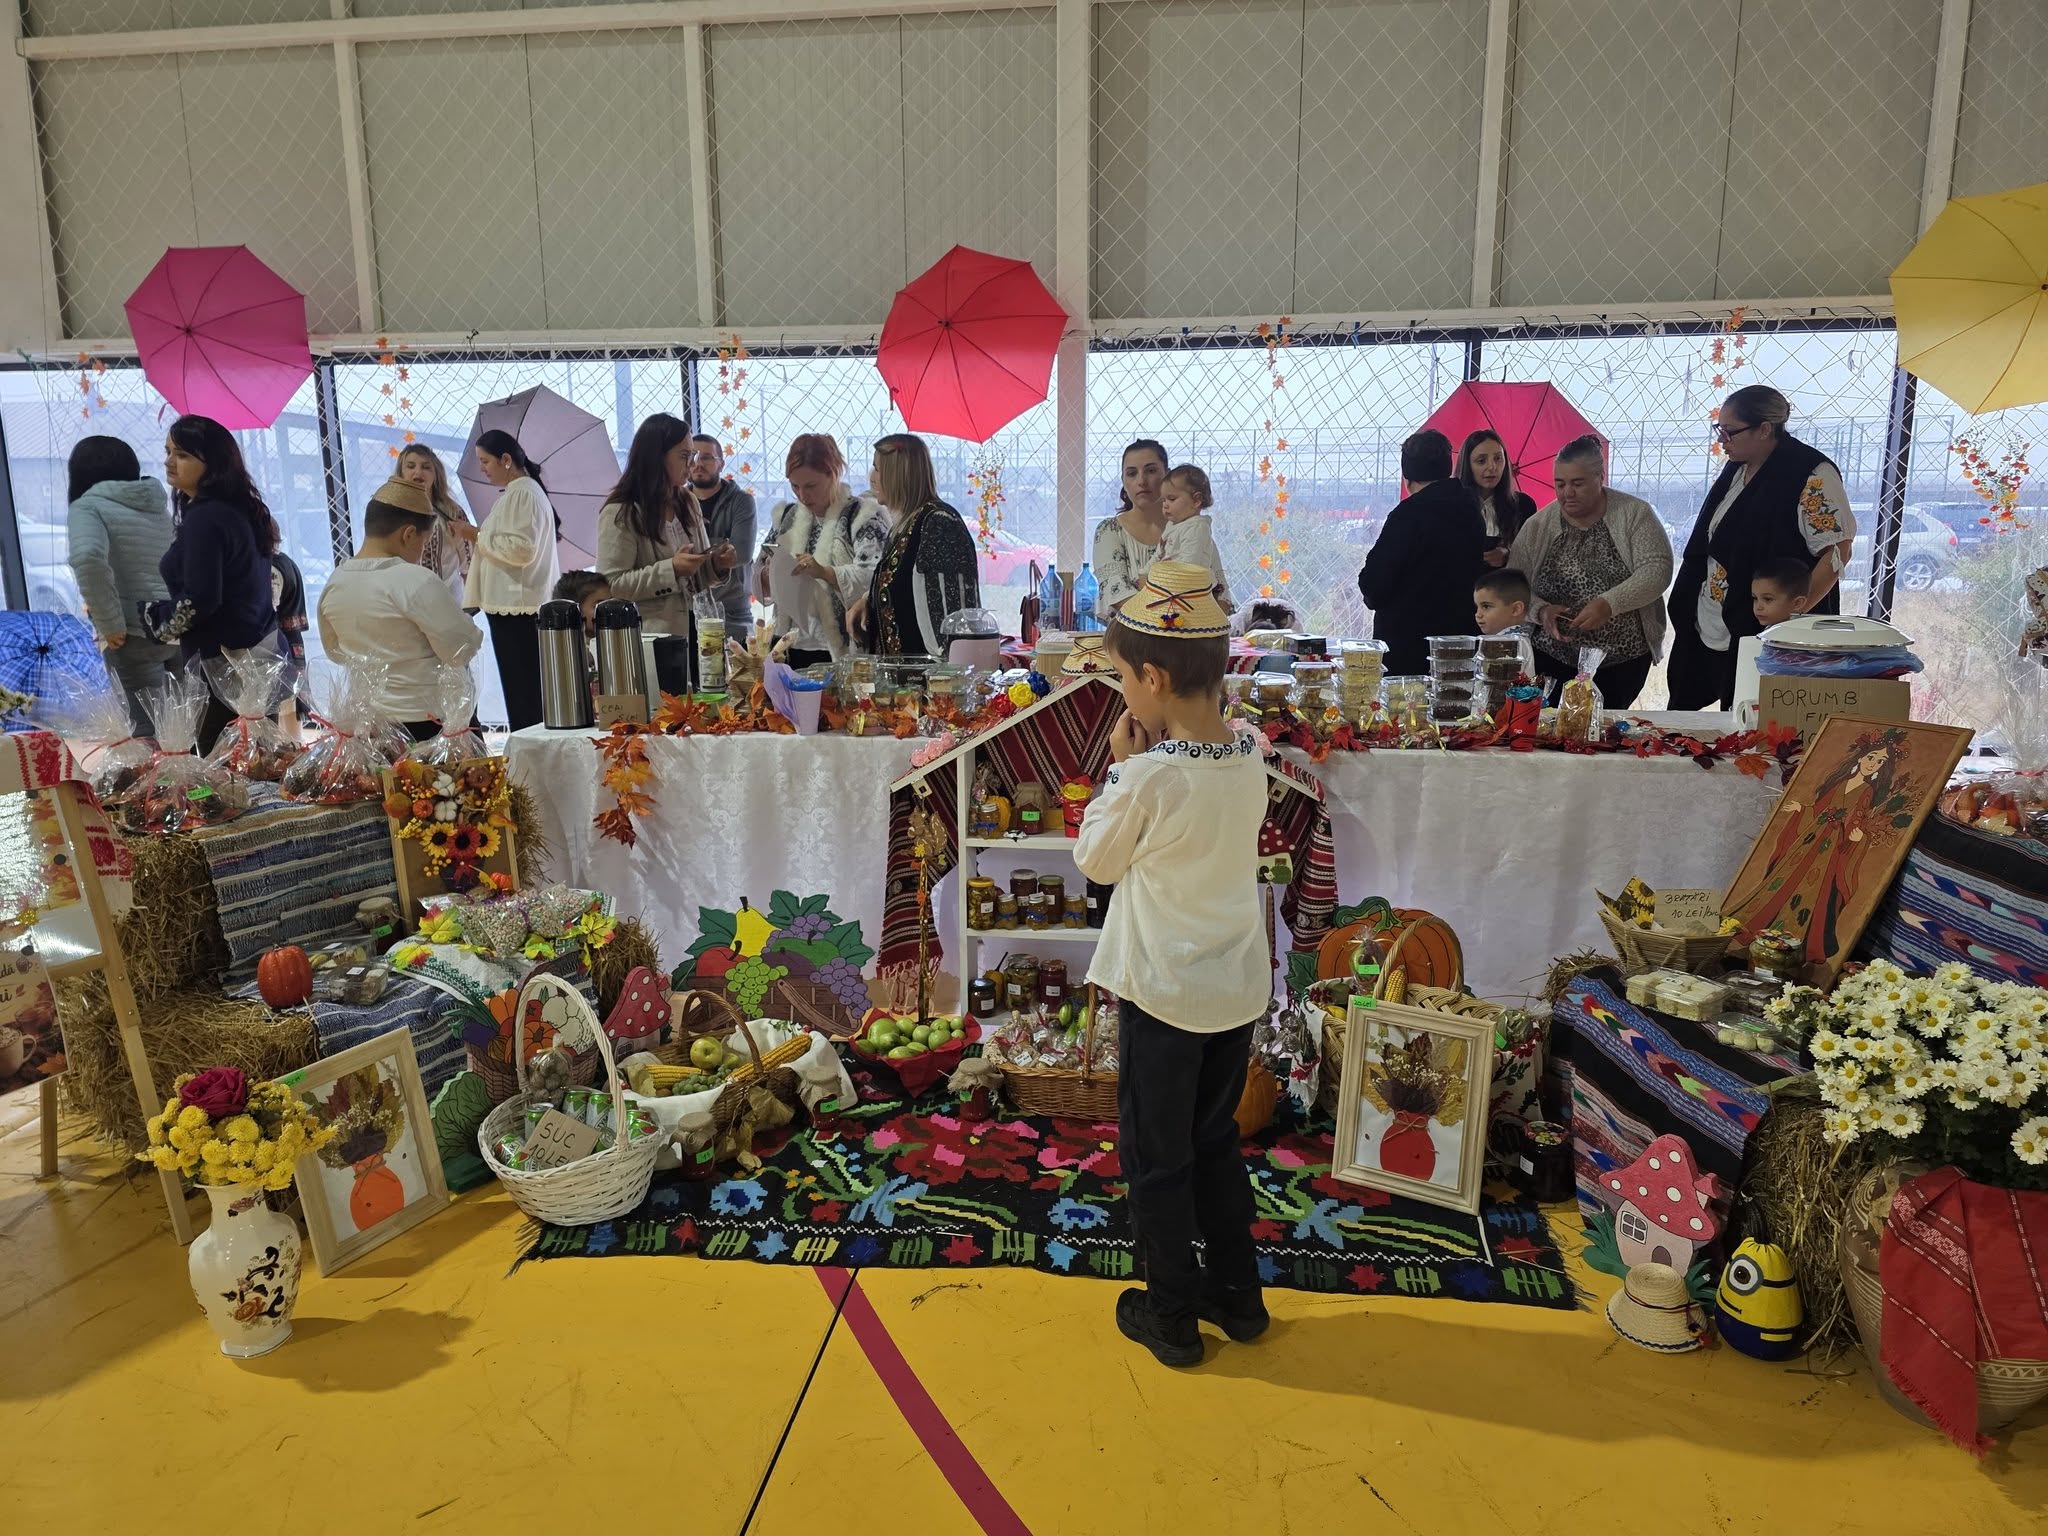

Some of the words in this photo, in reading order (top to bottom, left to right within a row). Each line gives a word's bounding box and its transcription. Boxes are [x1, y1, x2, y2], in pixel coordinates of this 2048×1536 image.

[1772, 688, 1858, 709] PORUMB
[1671, 909, 1684, 919] 10
[539, 1122, 576, 1149] SUC
[529, 1143, 546, 1160] 10
